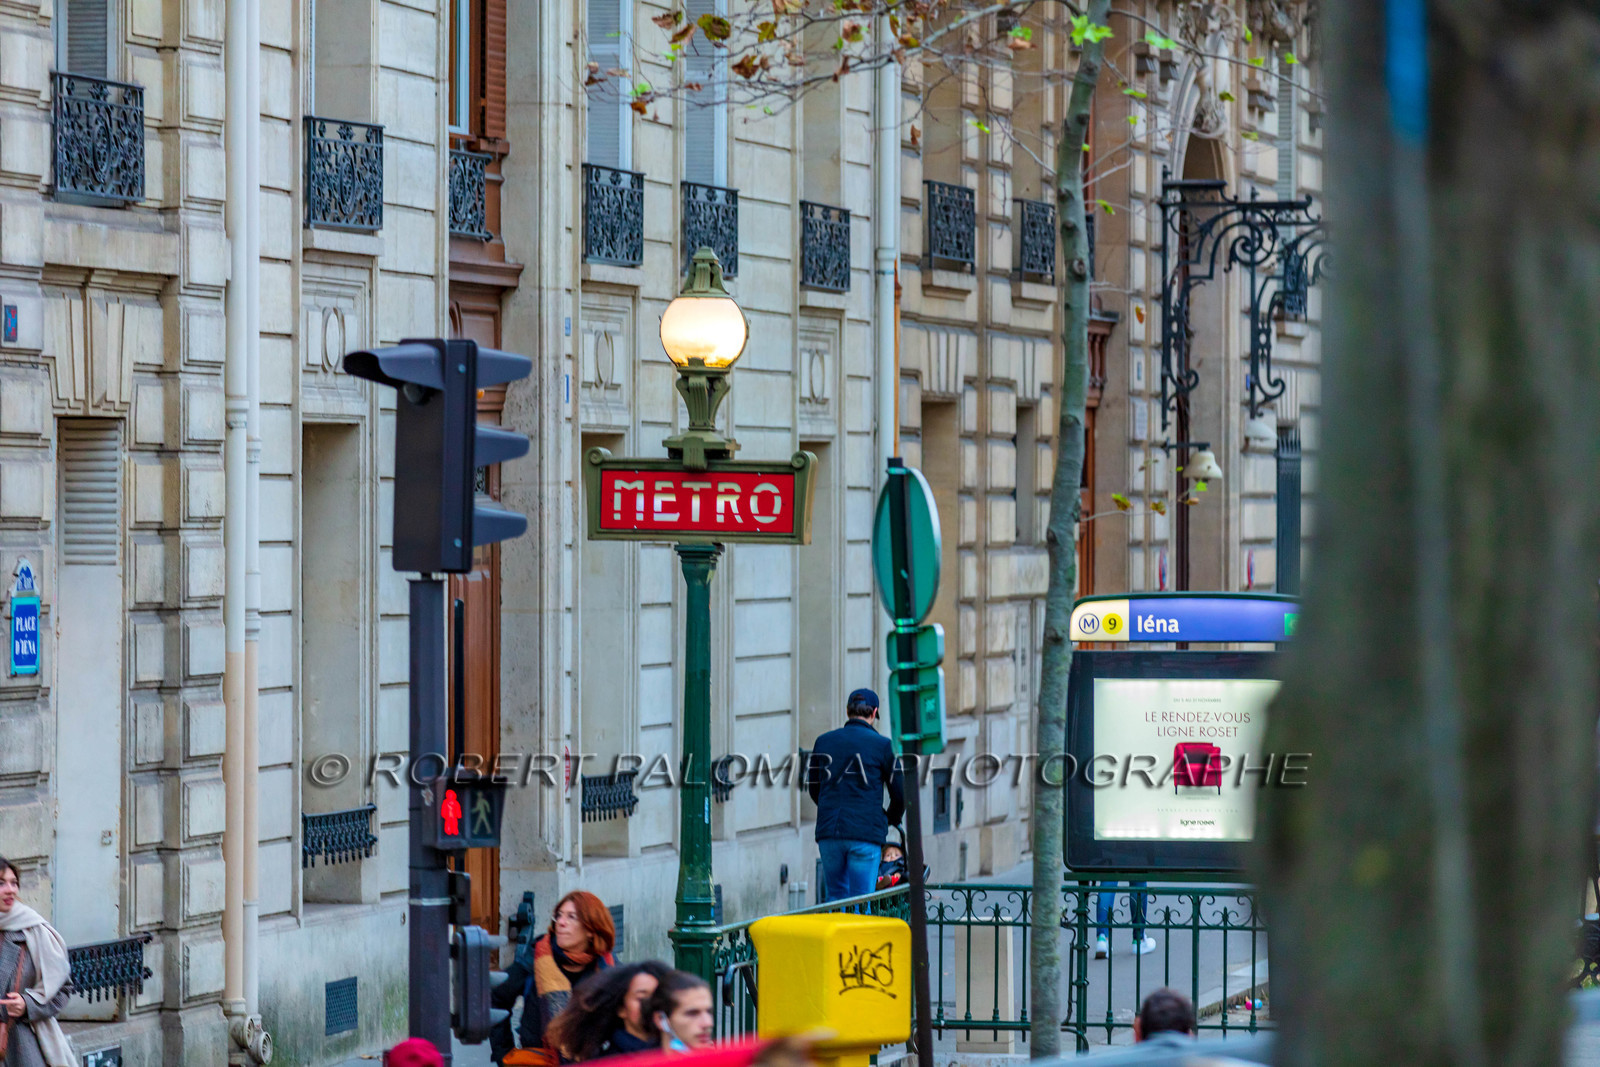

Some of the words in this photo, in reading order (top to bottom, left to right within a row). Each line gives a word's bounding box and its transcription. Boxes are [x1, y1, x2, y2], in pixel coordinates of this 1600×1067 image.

[613, 479, 782, 524] METRO
[15, 616, 36, 632] PLACE
[1108, 617, 1117, 630] 9
[1137, 614, 1180, 633] Iéna
[1145, 711, 1157, 723] LE
[1161, 711, 1251, 723] RENDEZ-VOUS
[1157, 726, 1195, 737] LIGNE
[1199, 726, 1239, 738] ROSET
